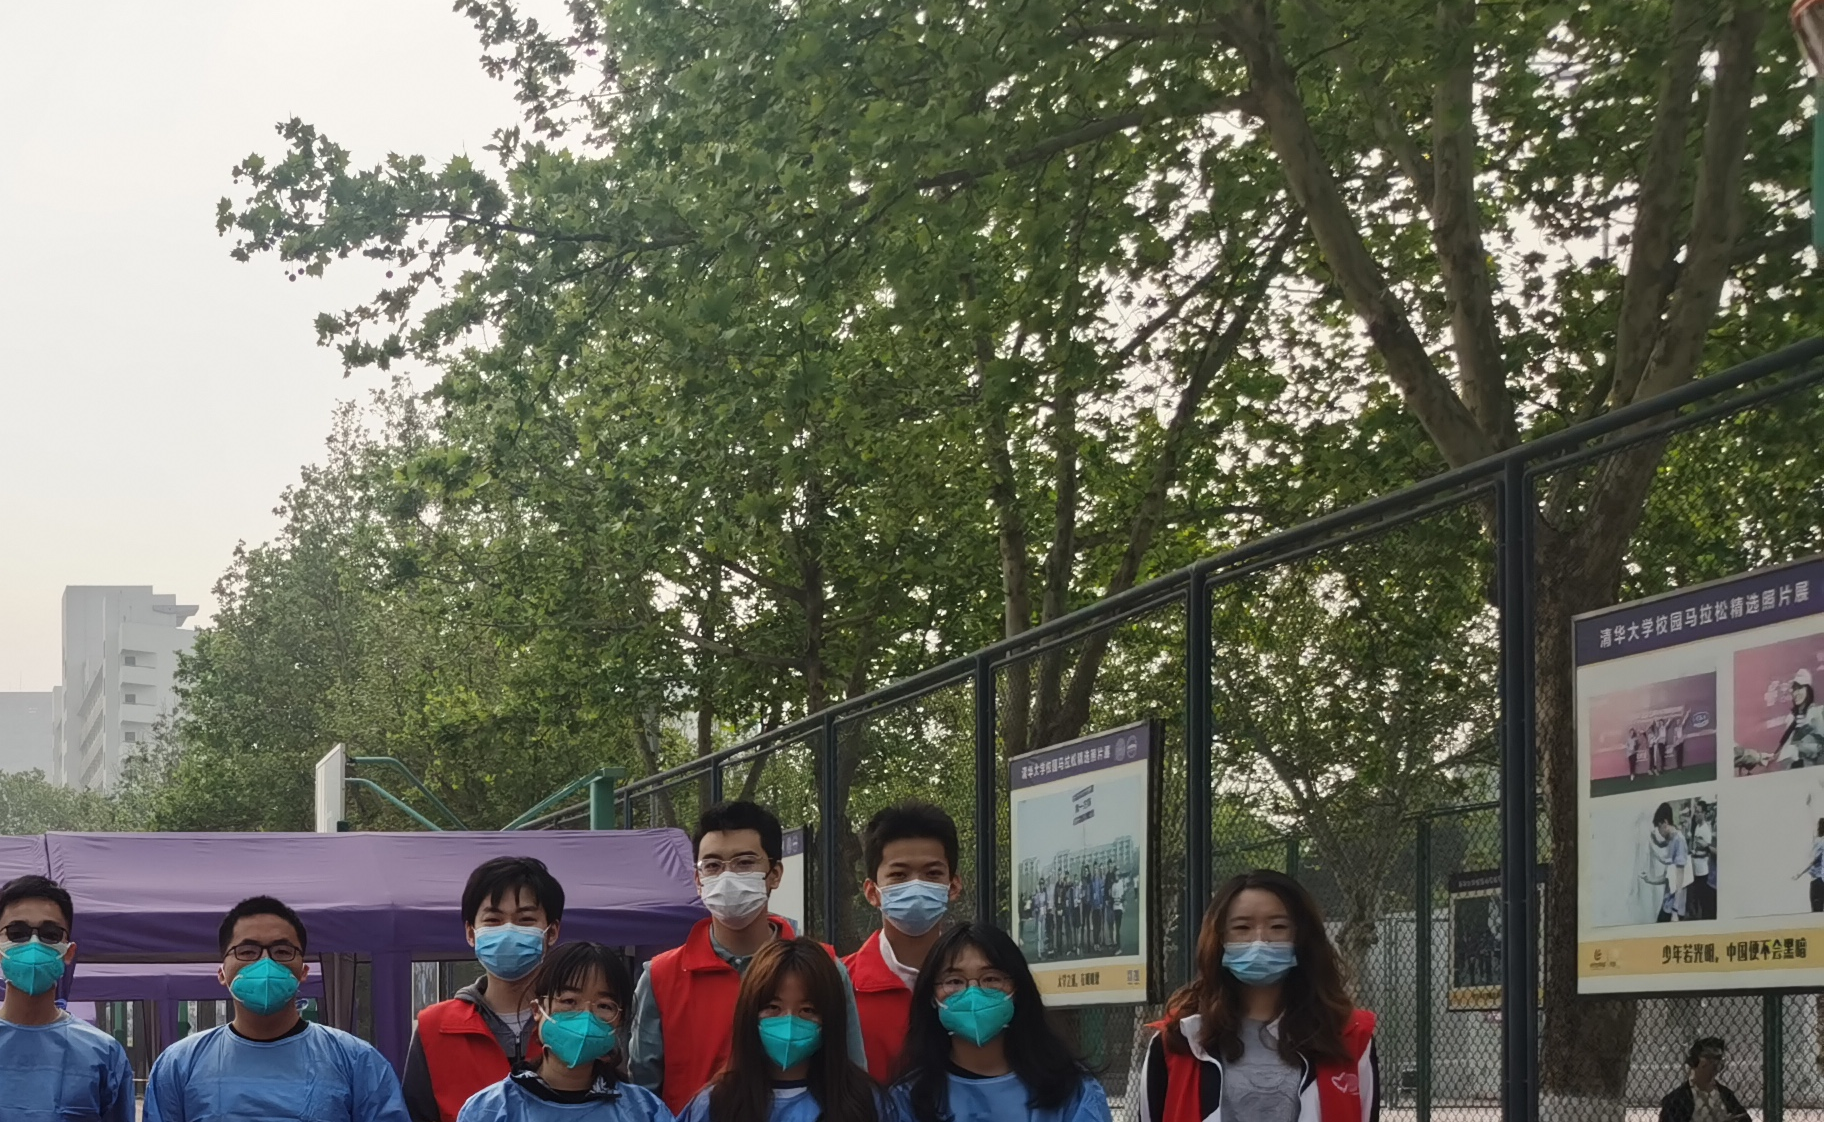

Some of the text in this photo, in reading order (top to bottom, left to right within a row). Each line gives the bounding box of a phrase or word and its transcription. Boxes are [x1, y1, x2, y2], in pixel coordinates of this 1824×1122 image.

[1599, 580, 1809, 649] 清华大学校园马拉松精选照片展
